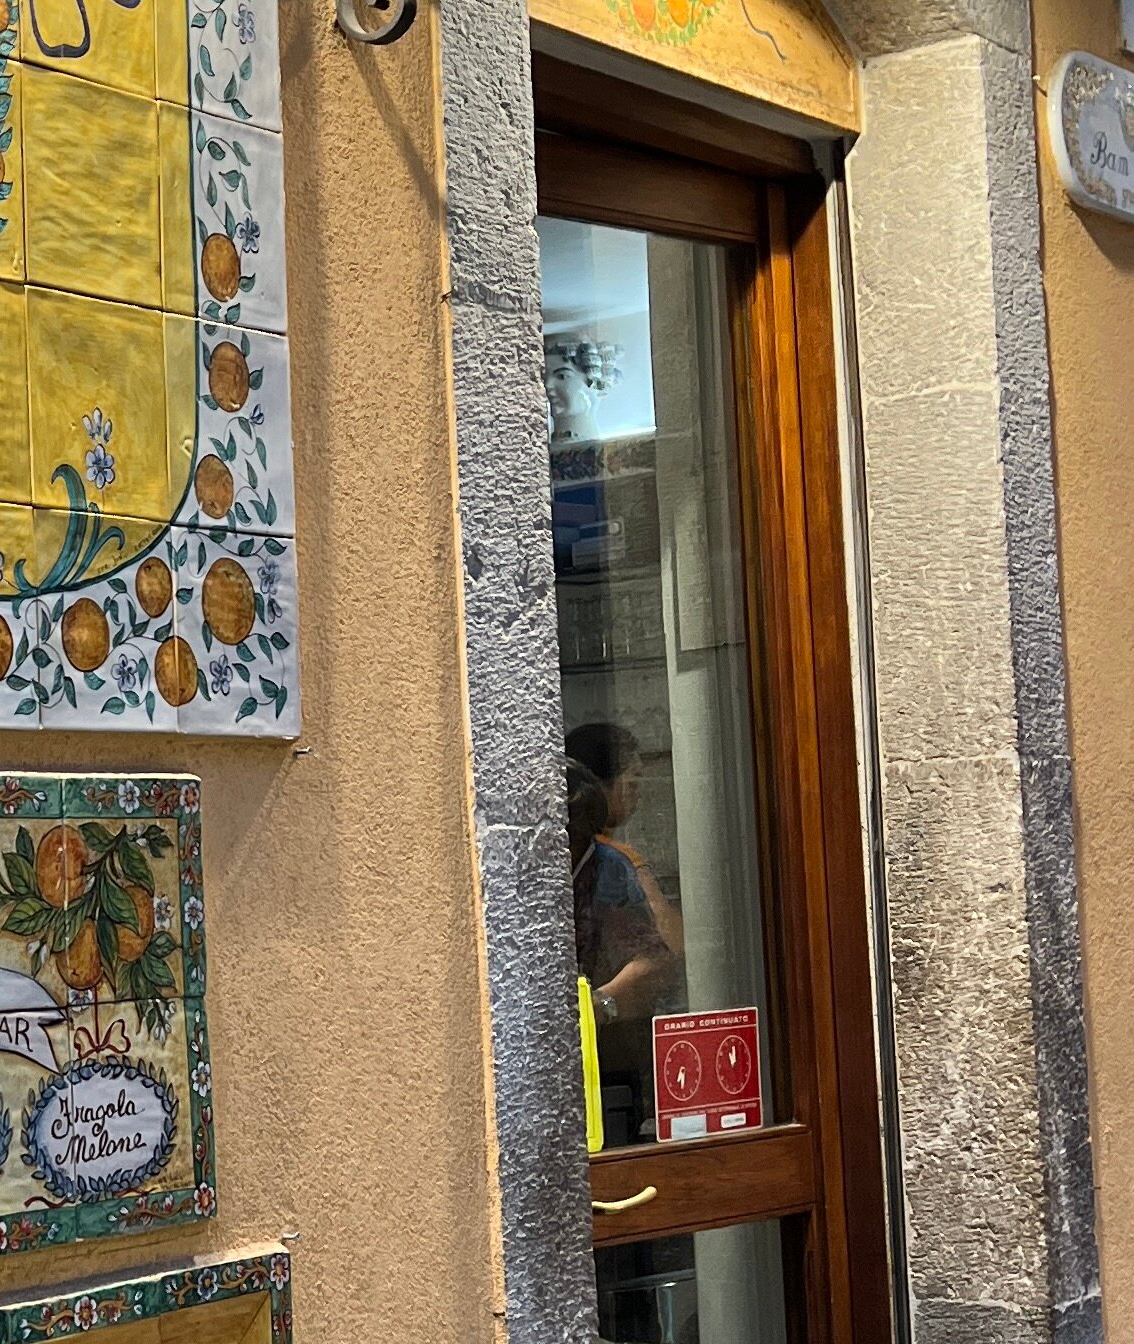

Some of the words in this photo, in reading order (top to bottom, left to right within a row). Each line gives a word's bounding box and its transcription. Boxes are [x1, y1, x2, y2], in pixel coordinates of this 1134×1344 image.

[1089, 130, 1130, 177] Bam
[664, 1020, 695, 1031] ORARIO
[699, 1015, 748, 1027] CONTINUATO
[50, 1089, 145, 1140] Fragola
[54, 1128, 148, 1167] Melone
